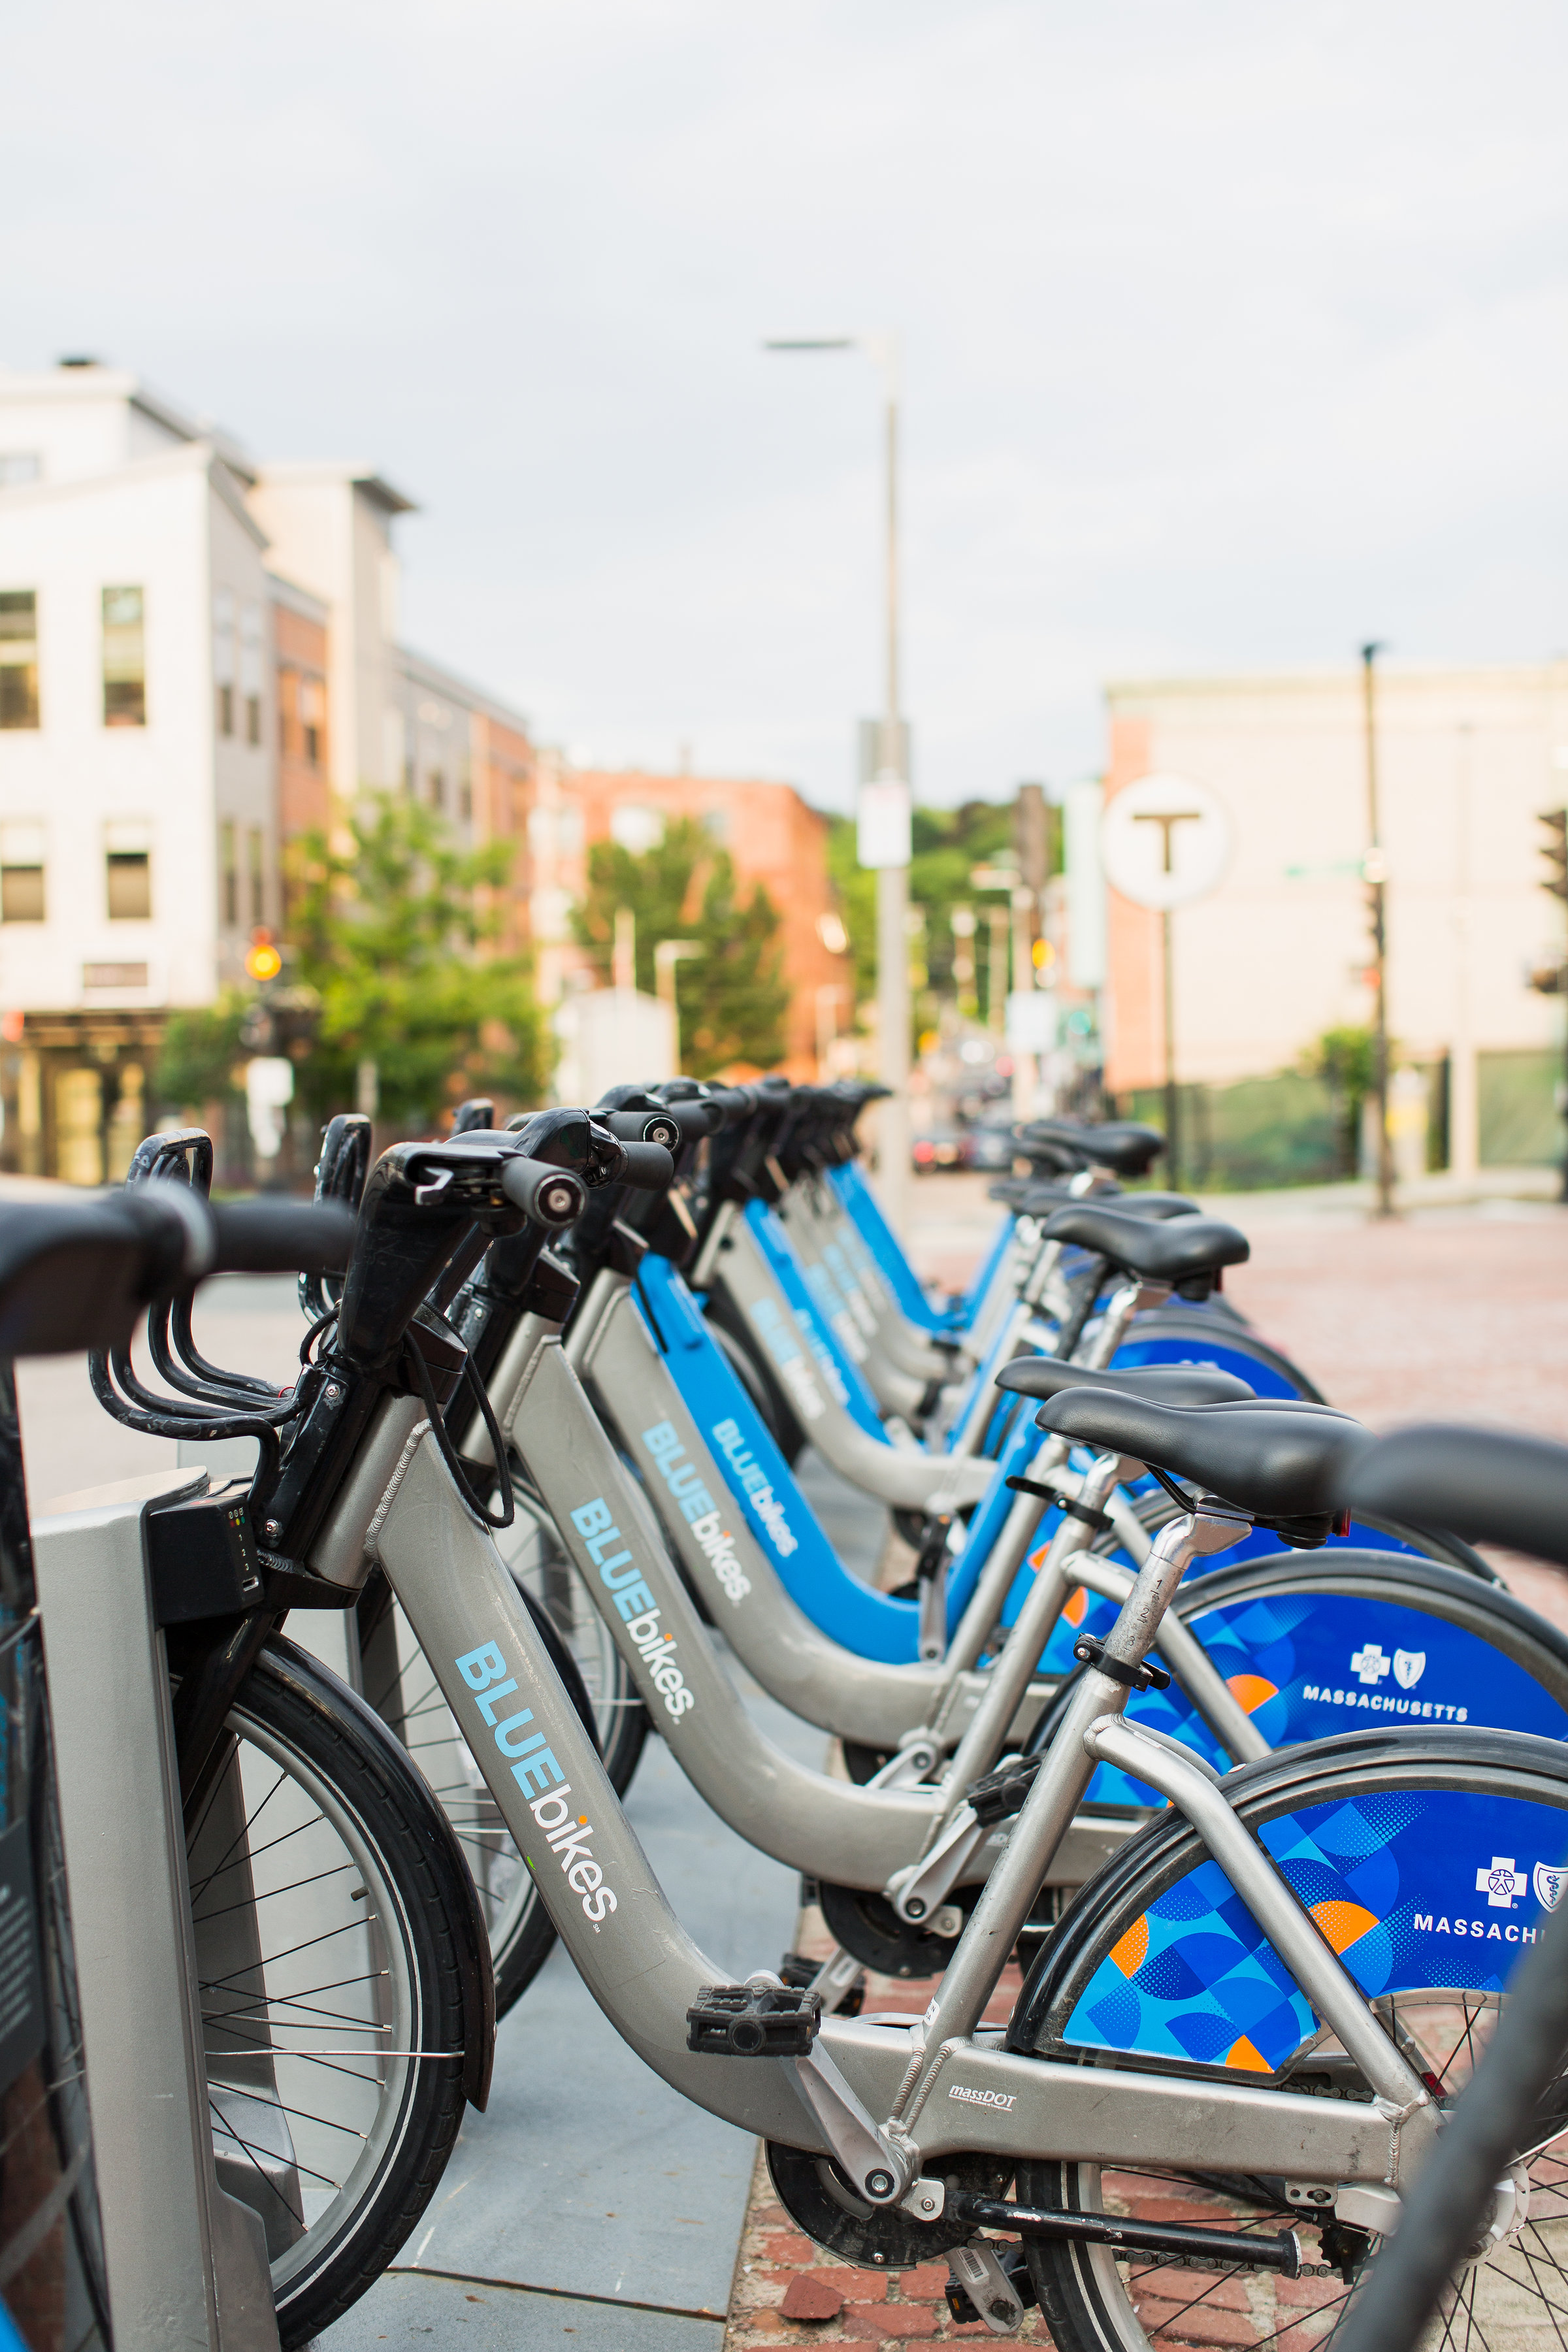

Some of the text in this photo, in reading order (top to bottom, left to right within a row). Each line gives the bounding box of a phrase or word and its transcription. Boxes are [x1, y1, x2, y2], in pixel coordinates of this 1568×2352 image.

[1133, 812, 1200, 874] T
[642, 1420, 751, 1601] BLUEbikes
[712, 1418, 798, 1558] BLUEbikes
[570, 1497, 694, 1716] BLUEbikes
[1156, 1579, 1163, 1590] 1
[1140, 1607, 1150, 1619] 2
[1303, 1686, 1468, 1722] MASSACHUSETTS
[455, 1640, 617, 1921] BLUEbikes
[1414, 1914, 1546, 1944] MASSACH
[949, 2085, 1017, 2108] massDOT
